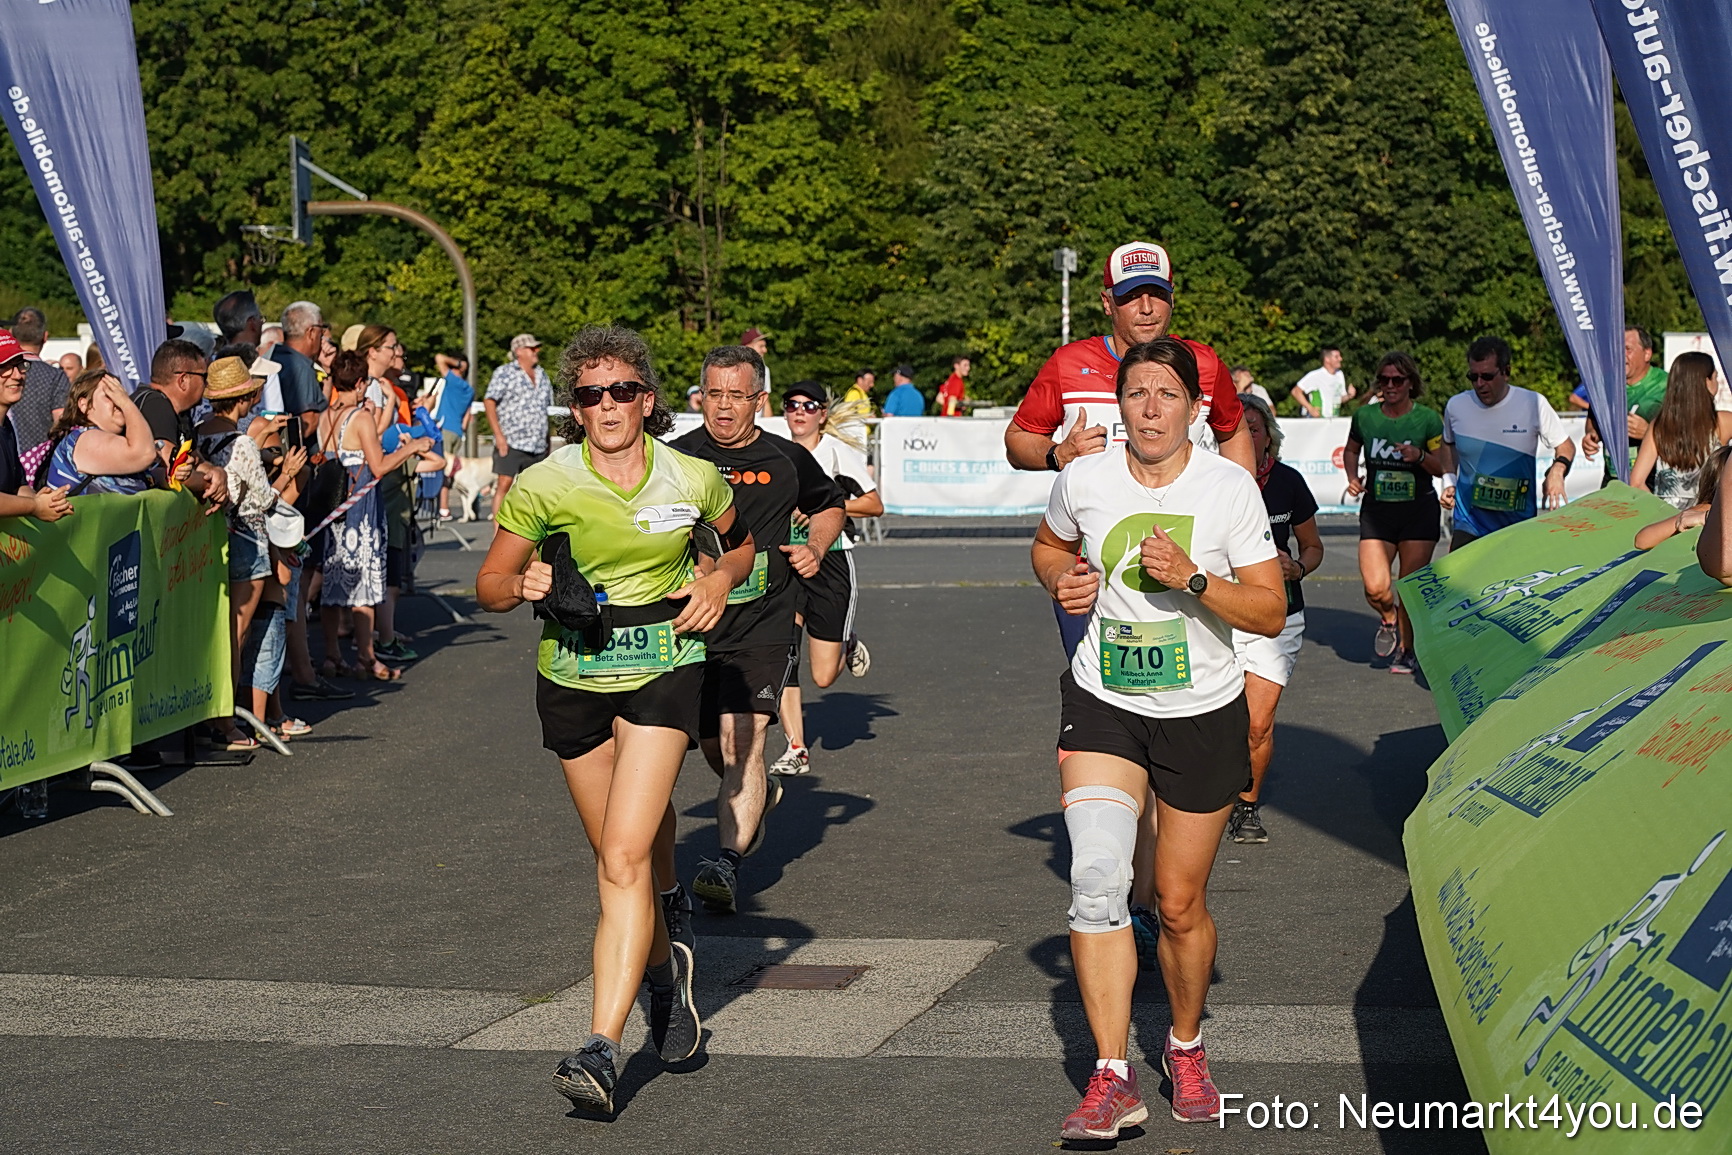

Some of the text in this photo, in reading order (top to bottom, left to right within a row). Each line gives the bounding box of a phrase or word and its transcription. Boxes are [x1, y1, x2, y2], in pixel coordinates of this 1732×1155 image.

[1123, 253, 1157, 265] STETSON
[903, 438, 937, 450] NOW
[905, 461, 956, 473] E-BIKES
[959, 462, 970, 473] &
[1381, 482, 1408, 492] 1464
[1481, 486, 1510, 500] 1190
[731, 585, 759, 596] Reinhard
[658, 630, 668, 661] 2022
[595, 652, 656, 662] Betz Roswitha
[1117, 645, 1164, 669] 710
[1174, 646, 1187, 679] 2022
[1103, 651, 1111, 676] RUN
